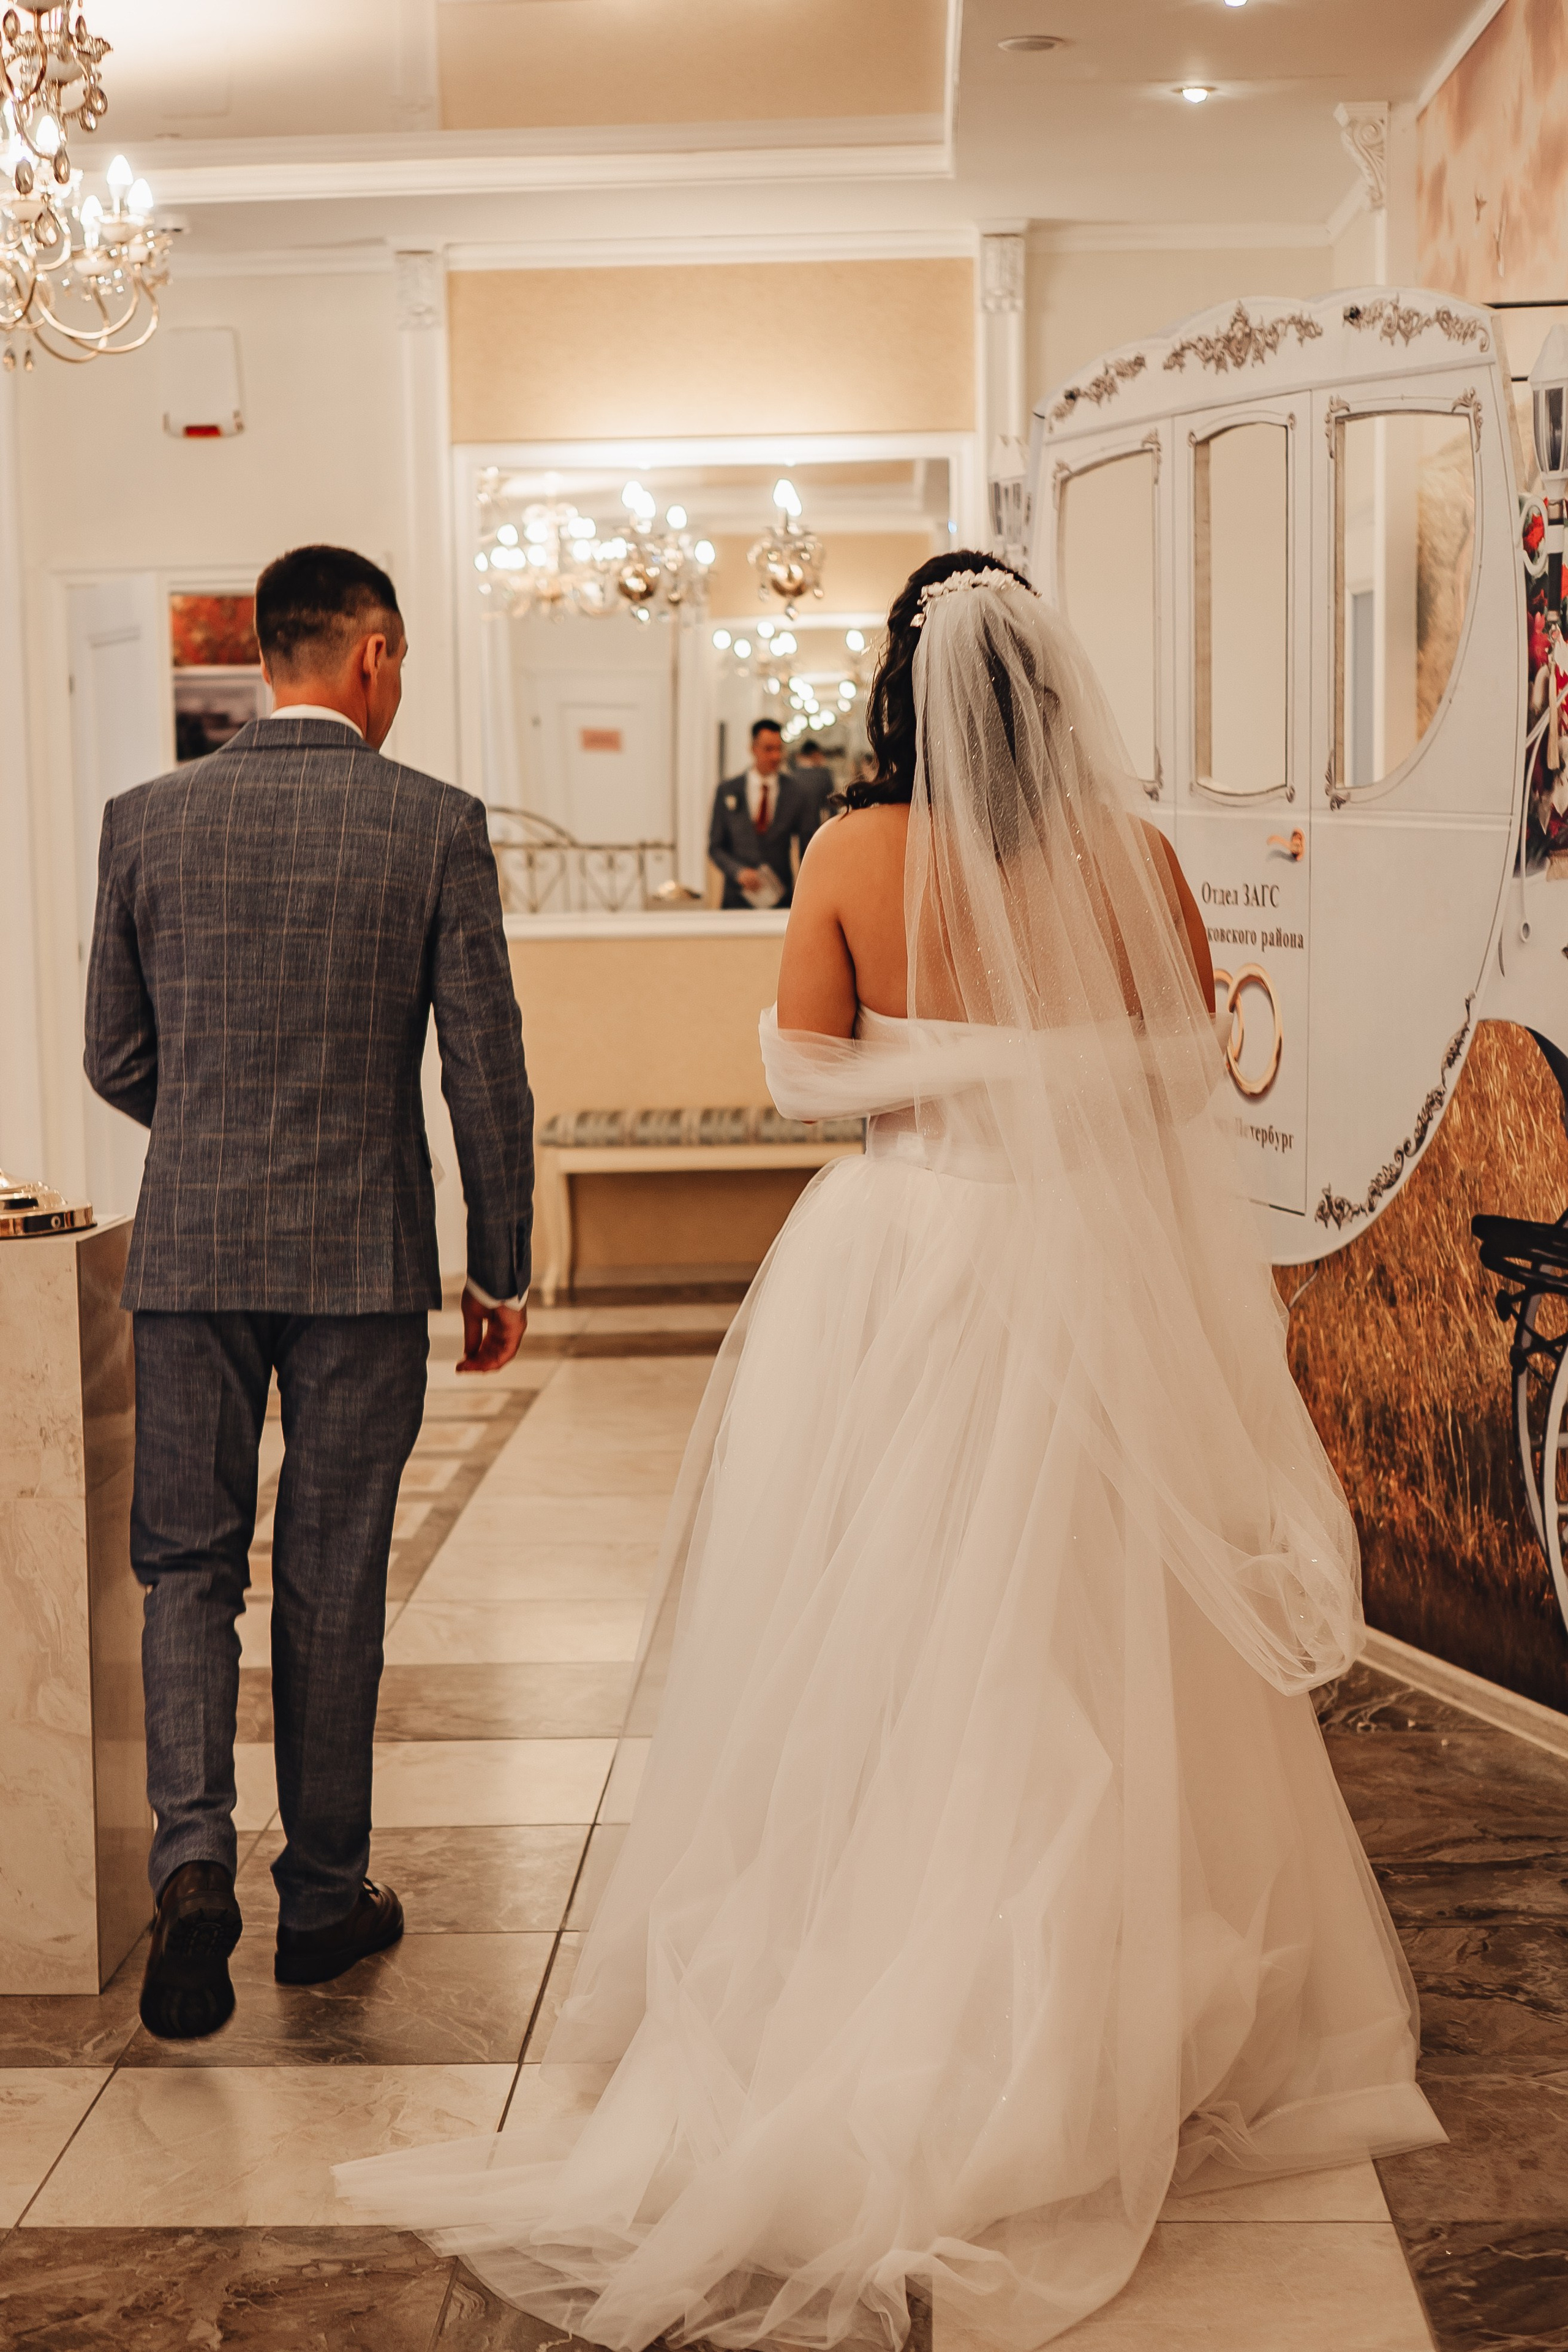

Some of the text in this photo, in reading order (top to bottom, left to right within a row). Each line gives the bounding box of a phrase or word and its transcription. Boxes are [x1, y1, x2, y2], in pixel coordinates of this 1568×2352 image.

[1202, 881, 1280, 908] Отдел ЗАГС
[1206, 926, 1304, 952] ковского района
